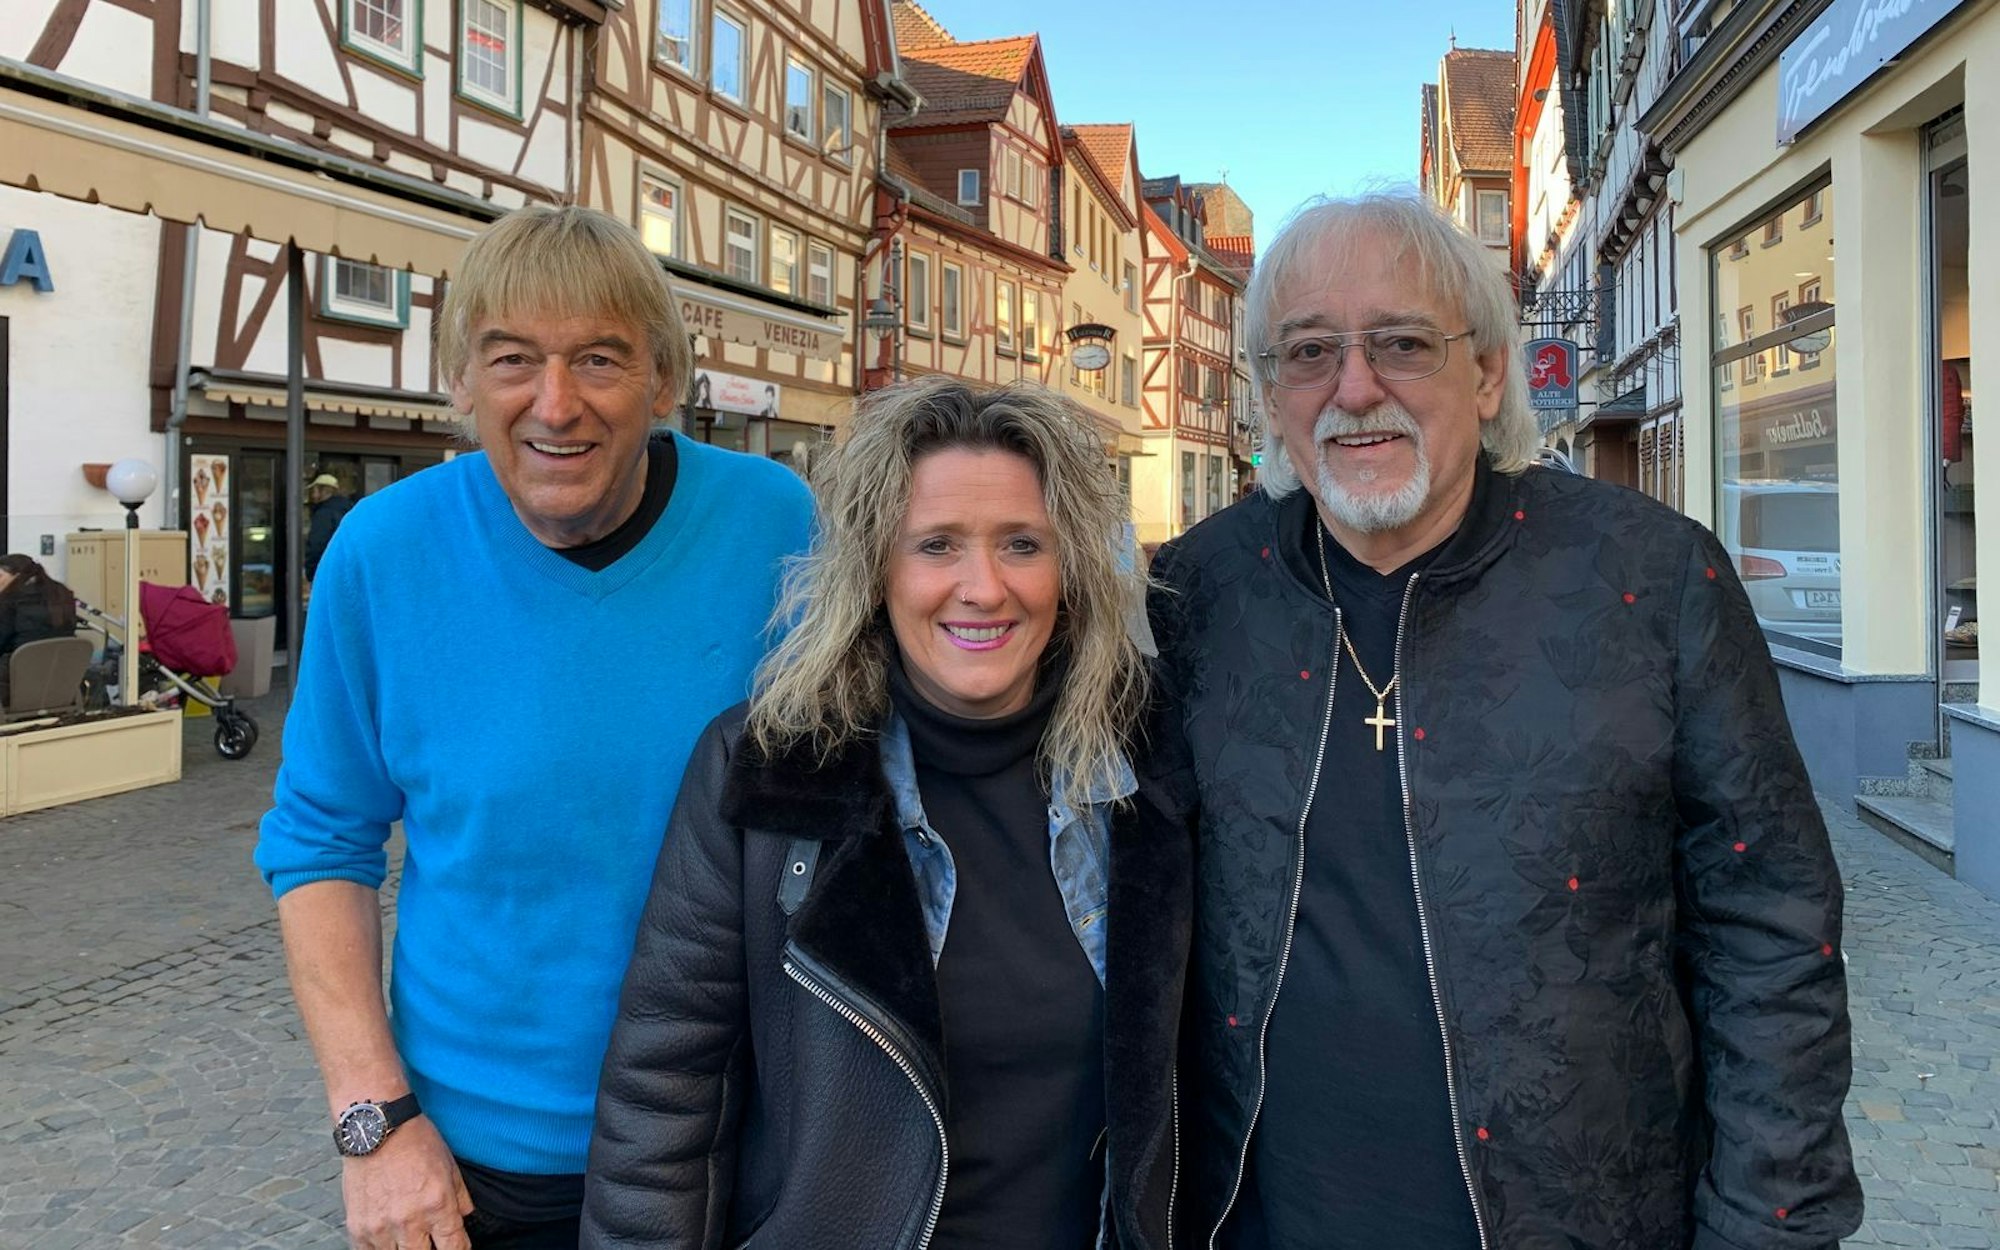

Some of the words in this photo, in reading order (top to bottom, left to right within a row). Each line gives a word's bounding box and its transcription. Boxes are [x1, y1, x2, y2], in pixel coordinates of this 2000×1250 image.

[0, 228, 54, 292] A
[682, 302, 723, 329] CAFE
[764, 322, 820, 351] VENEZIA
[1537, 390, 1561, 398] ALTE
